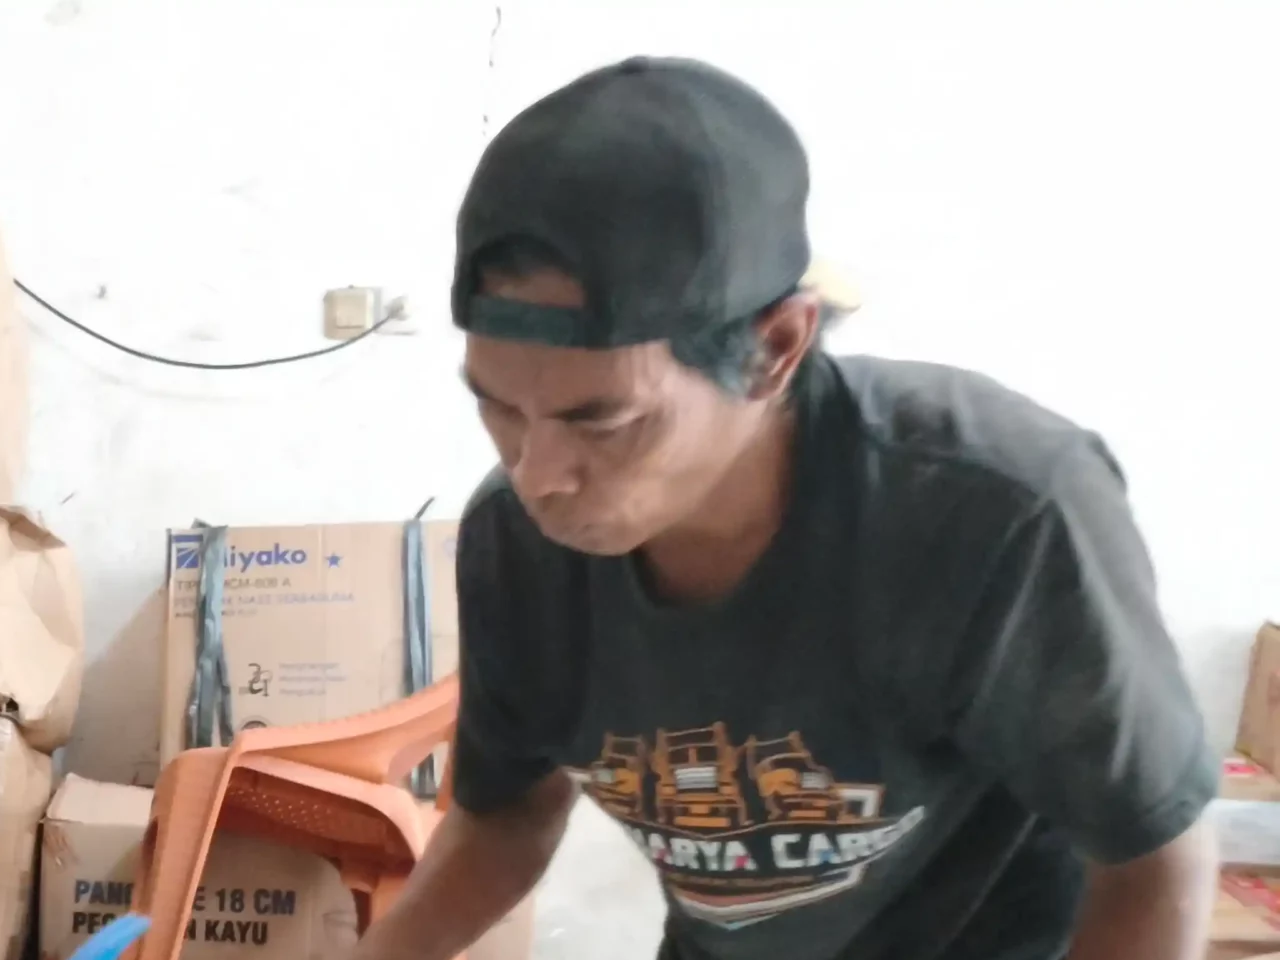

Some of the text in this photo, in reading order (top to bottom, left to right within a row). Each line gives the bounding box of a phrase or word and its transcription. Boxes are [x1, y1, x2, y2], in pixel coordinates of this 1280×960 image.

[222, 542, 307, 573] iyako
[215, 888, 245, 912] 18
[253, 889, 297, 915] CM
[205, 920, 268, 945] KAYU
